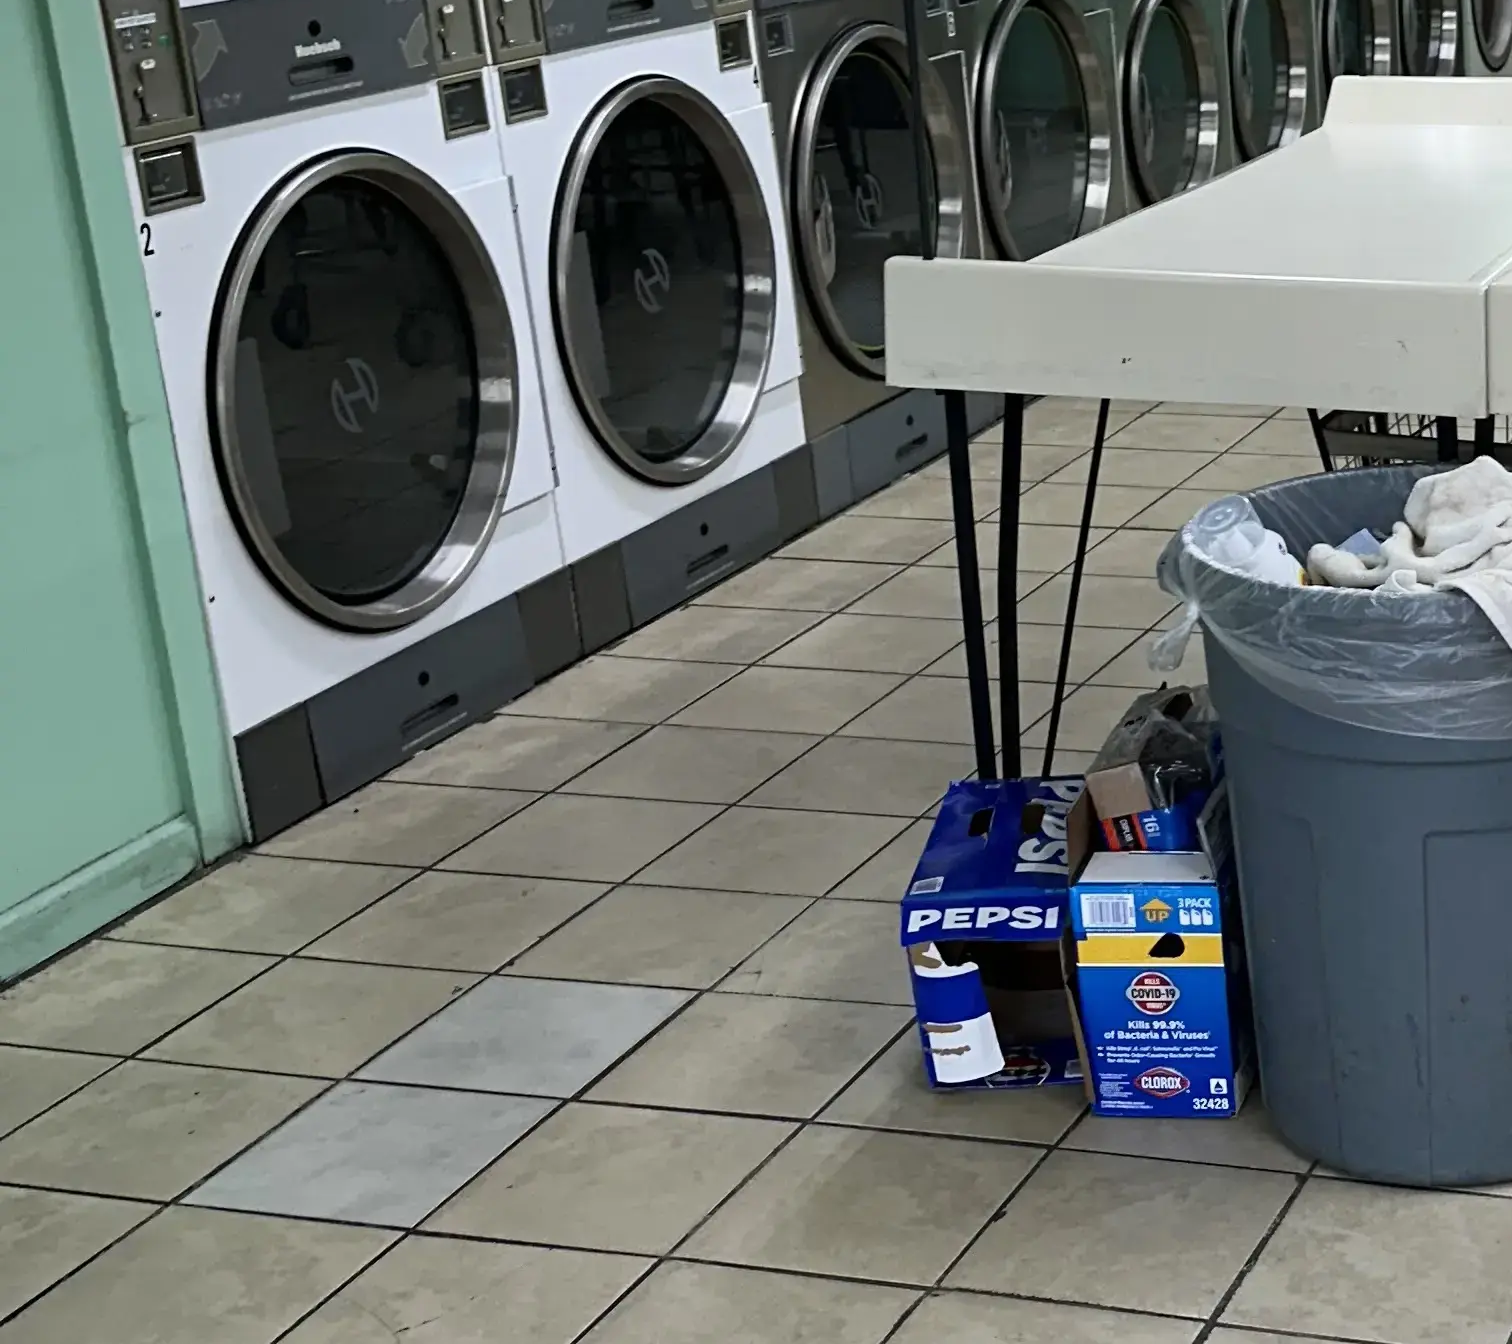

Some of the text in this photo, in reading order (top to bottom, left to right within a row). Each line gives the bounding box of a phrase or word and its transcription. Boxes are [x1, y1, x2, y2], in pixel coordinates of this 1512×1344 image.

[140, 222, 155, 257] 2
[1177, 897, 1212, 908] 3 PACK
[907, 905, 1060, 934] PEPSI
[1145, 910, 1170, 923] UP
[1131, 988, 1176, 999] COVID-19
[1128, 1020, 1186, 1030] Kills 99.9%
[1104, 1030, 1115, 1039] of
[1117, 1030, 1160, 1040] Bacteria
[1161, 1031, 1169, 1040] &
[1141, 1076, 1182, 1089] CLOROX
[1192, 1097, 1229, 1110] 32428
